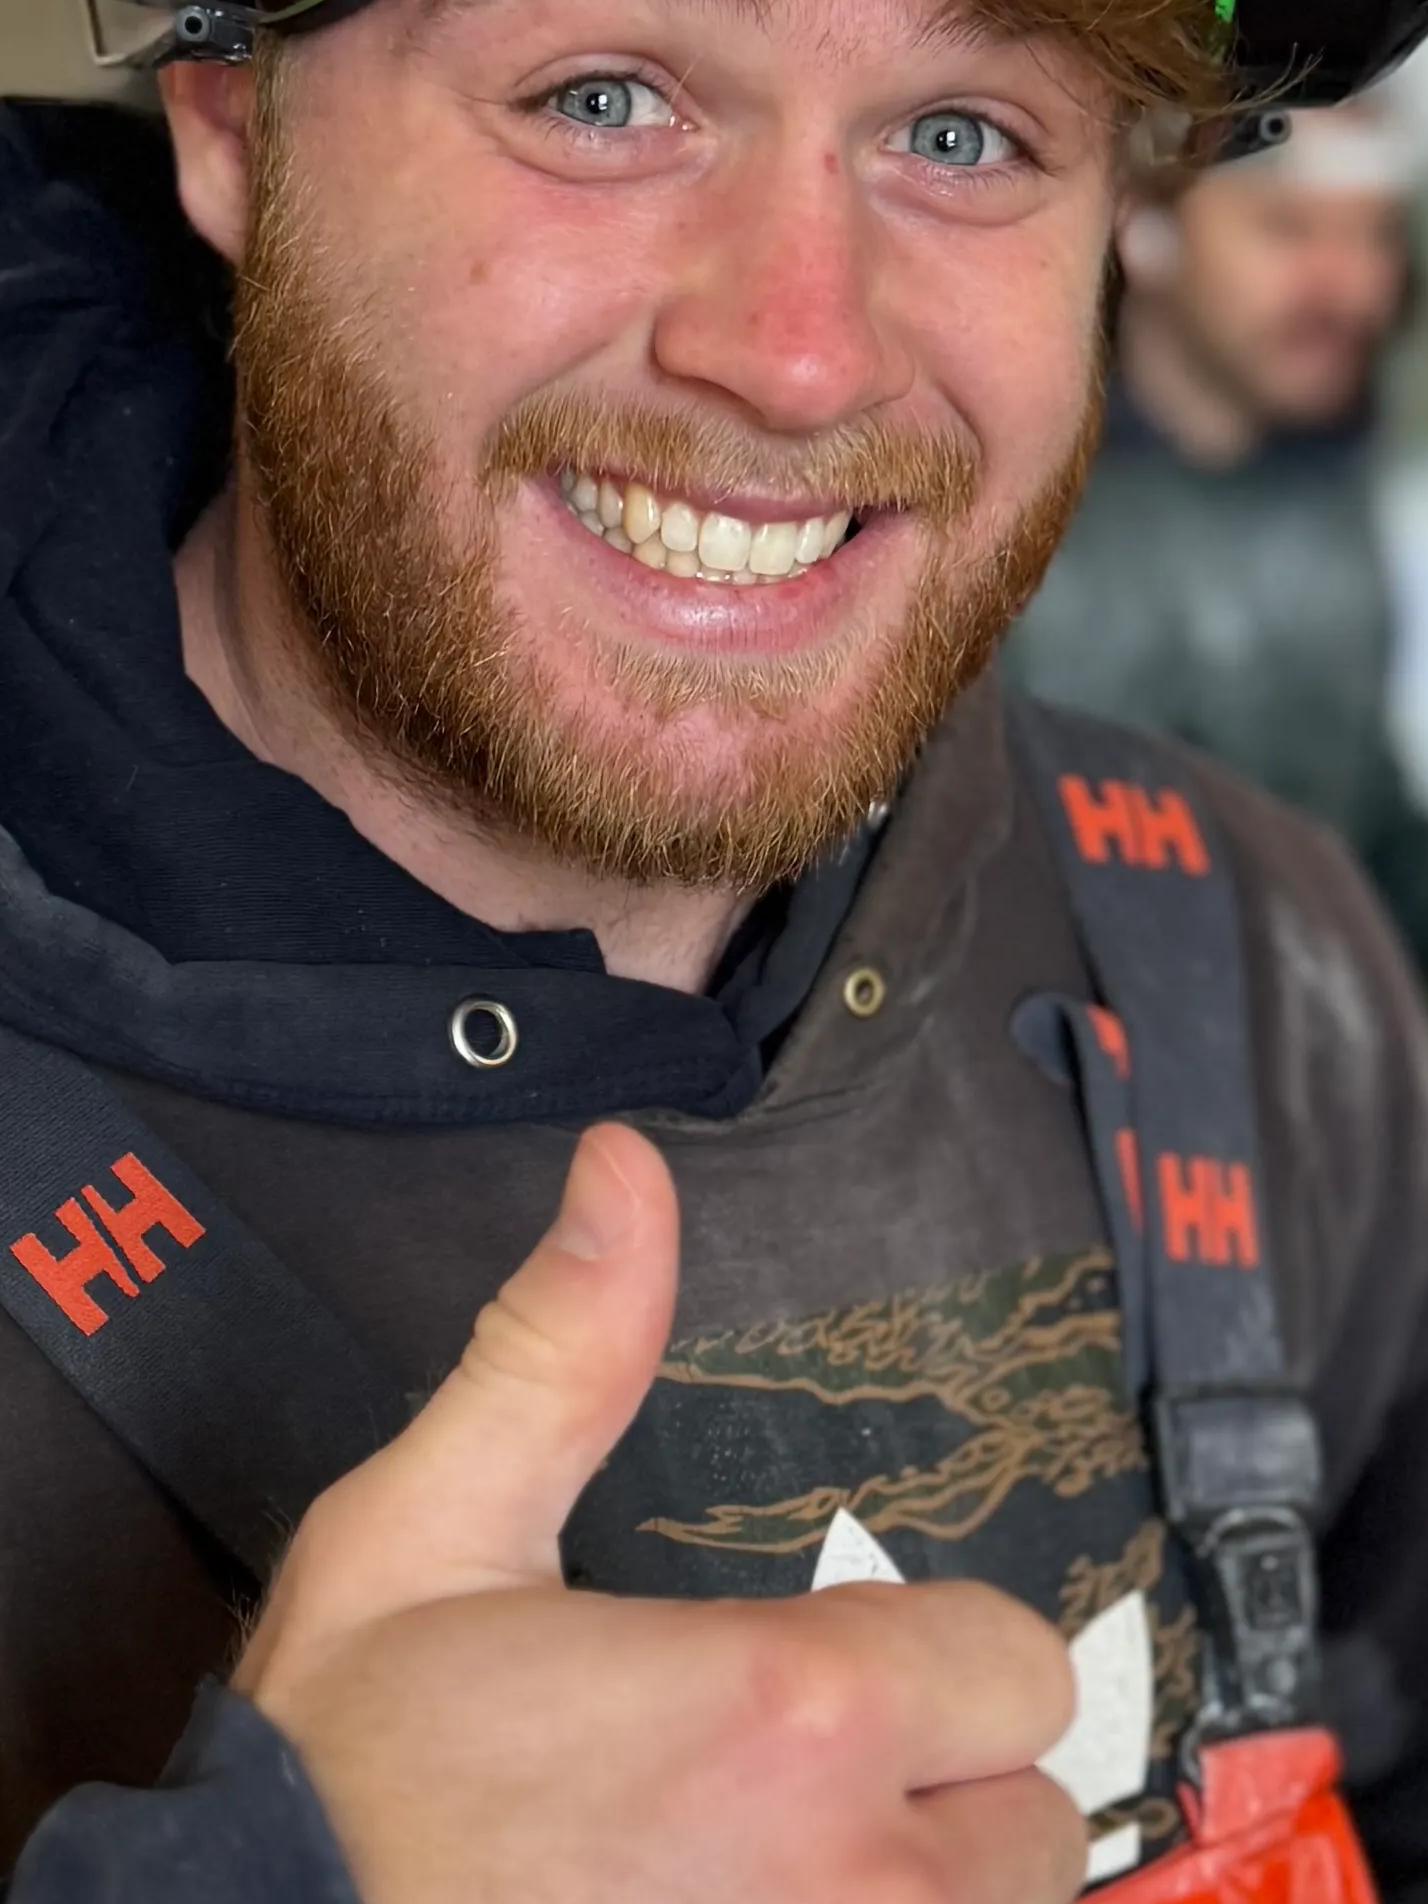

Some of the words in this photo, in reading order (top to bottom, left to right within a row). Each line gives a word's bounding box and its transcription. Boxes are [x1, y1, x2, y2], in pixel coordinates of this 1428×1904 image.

[1059, 774, 1211, 876] HH
[10, 1152, 206, 1336] HH
[1157, 1152, 1260, 1270] HH
